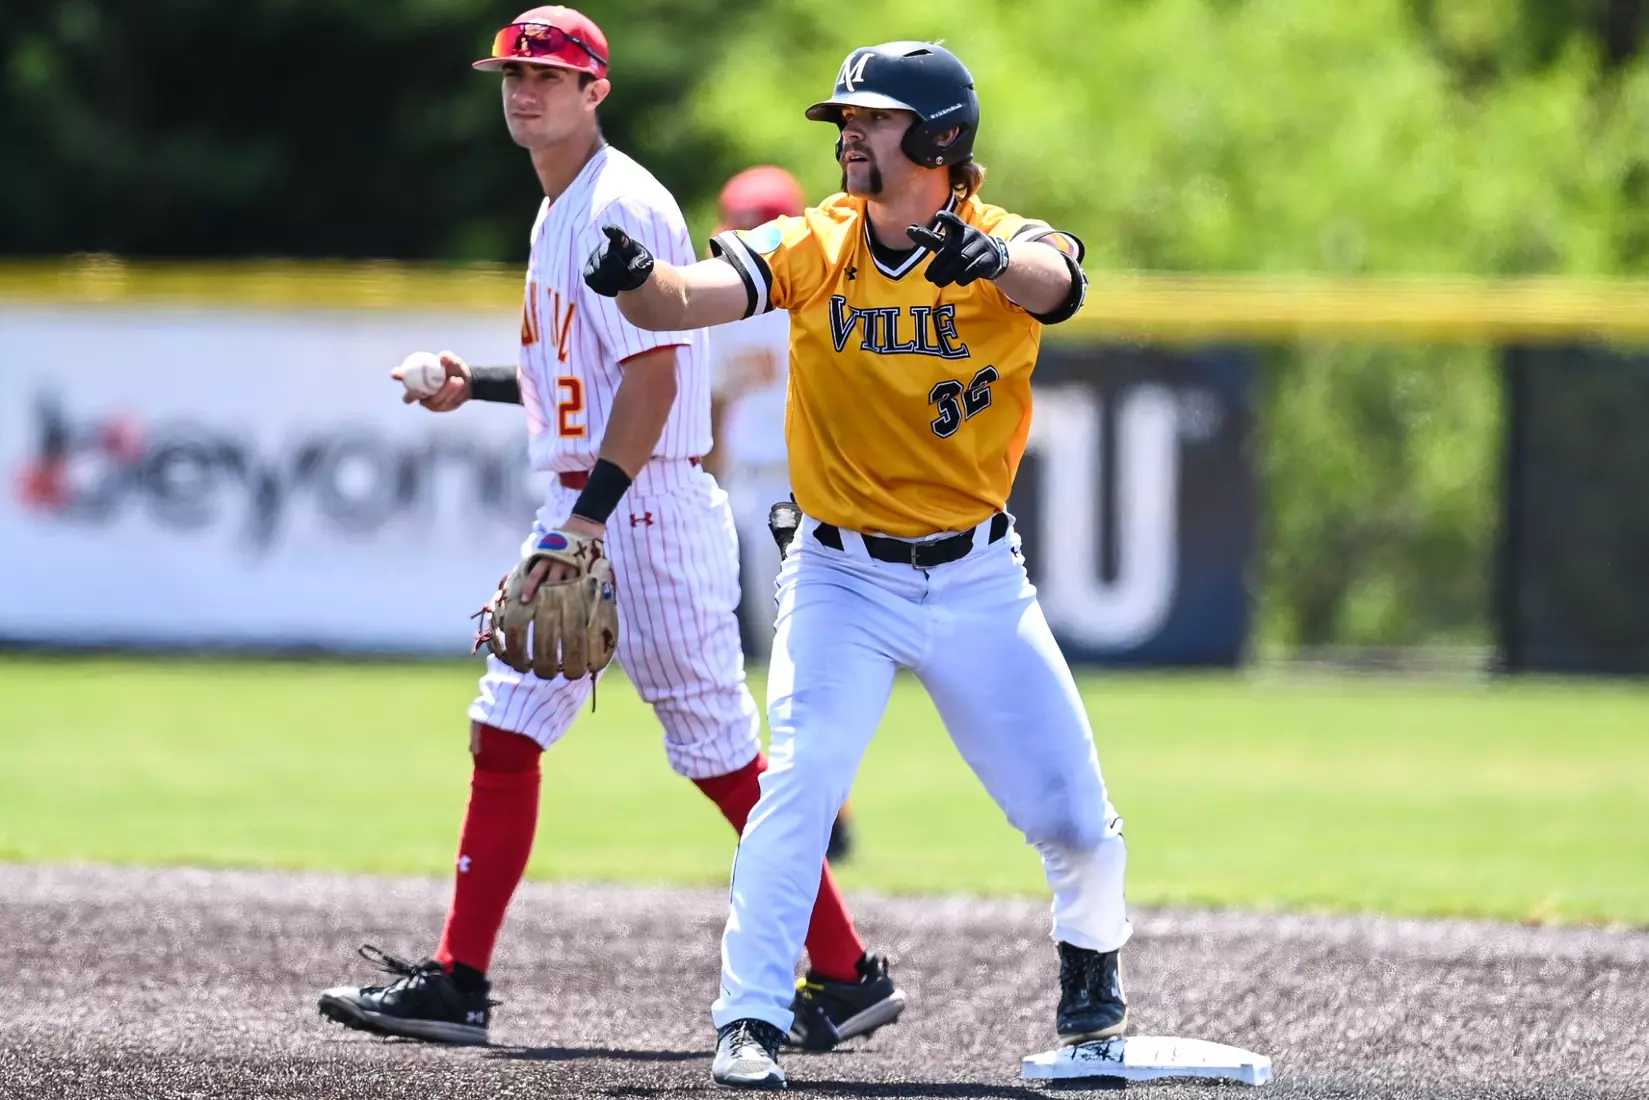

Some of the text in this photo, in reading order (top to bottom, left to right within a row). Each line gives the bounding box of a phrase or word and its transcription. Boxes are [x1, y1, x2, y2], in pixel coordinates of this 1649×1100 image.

[837, 52, 875, 92] M
[829, 294, 971, 360] VILLE
[557, 376, 587, 438] 2
